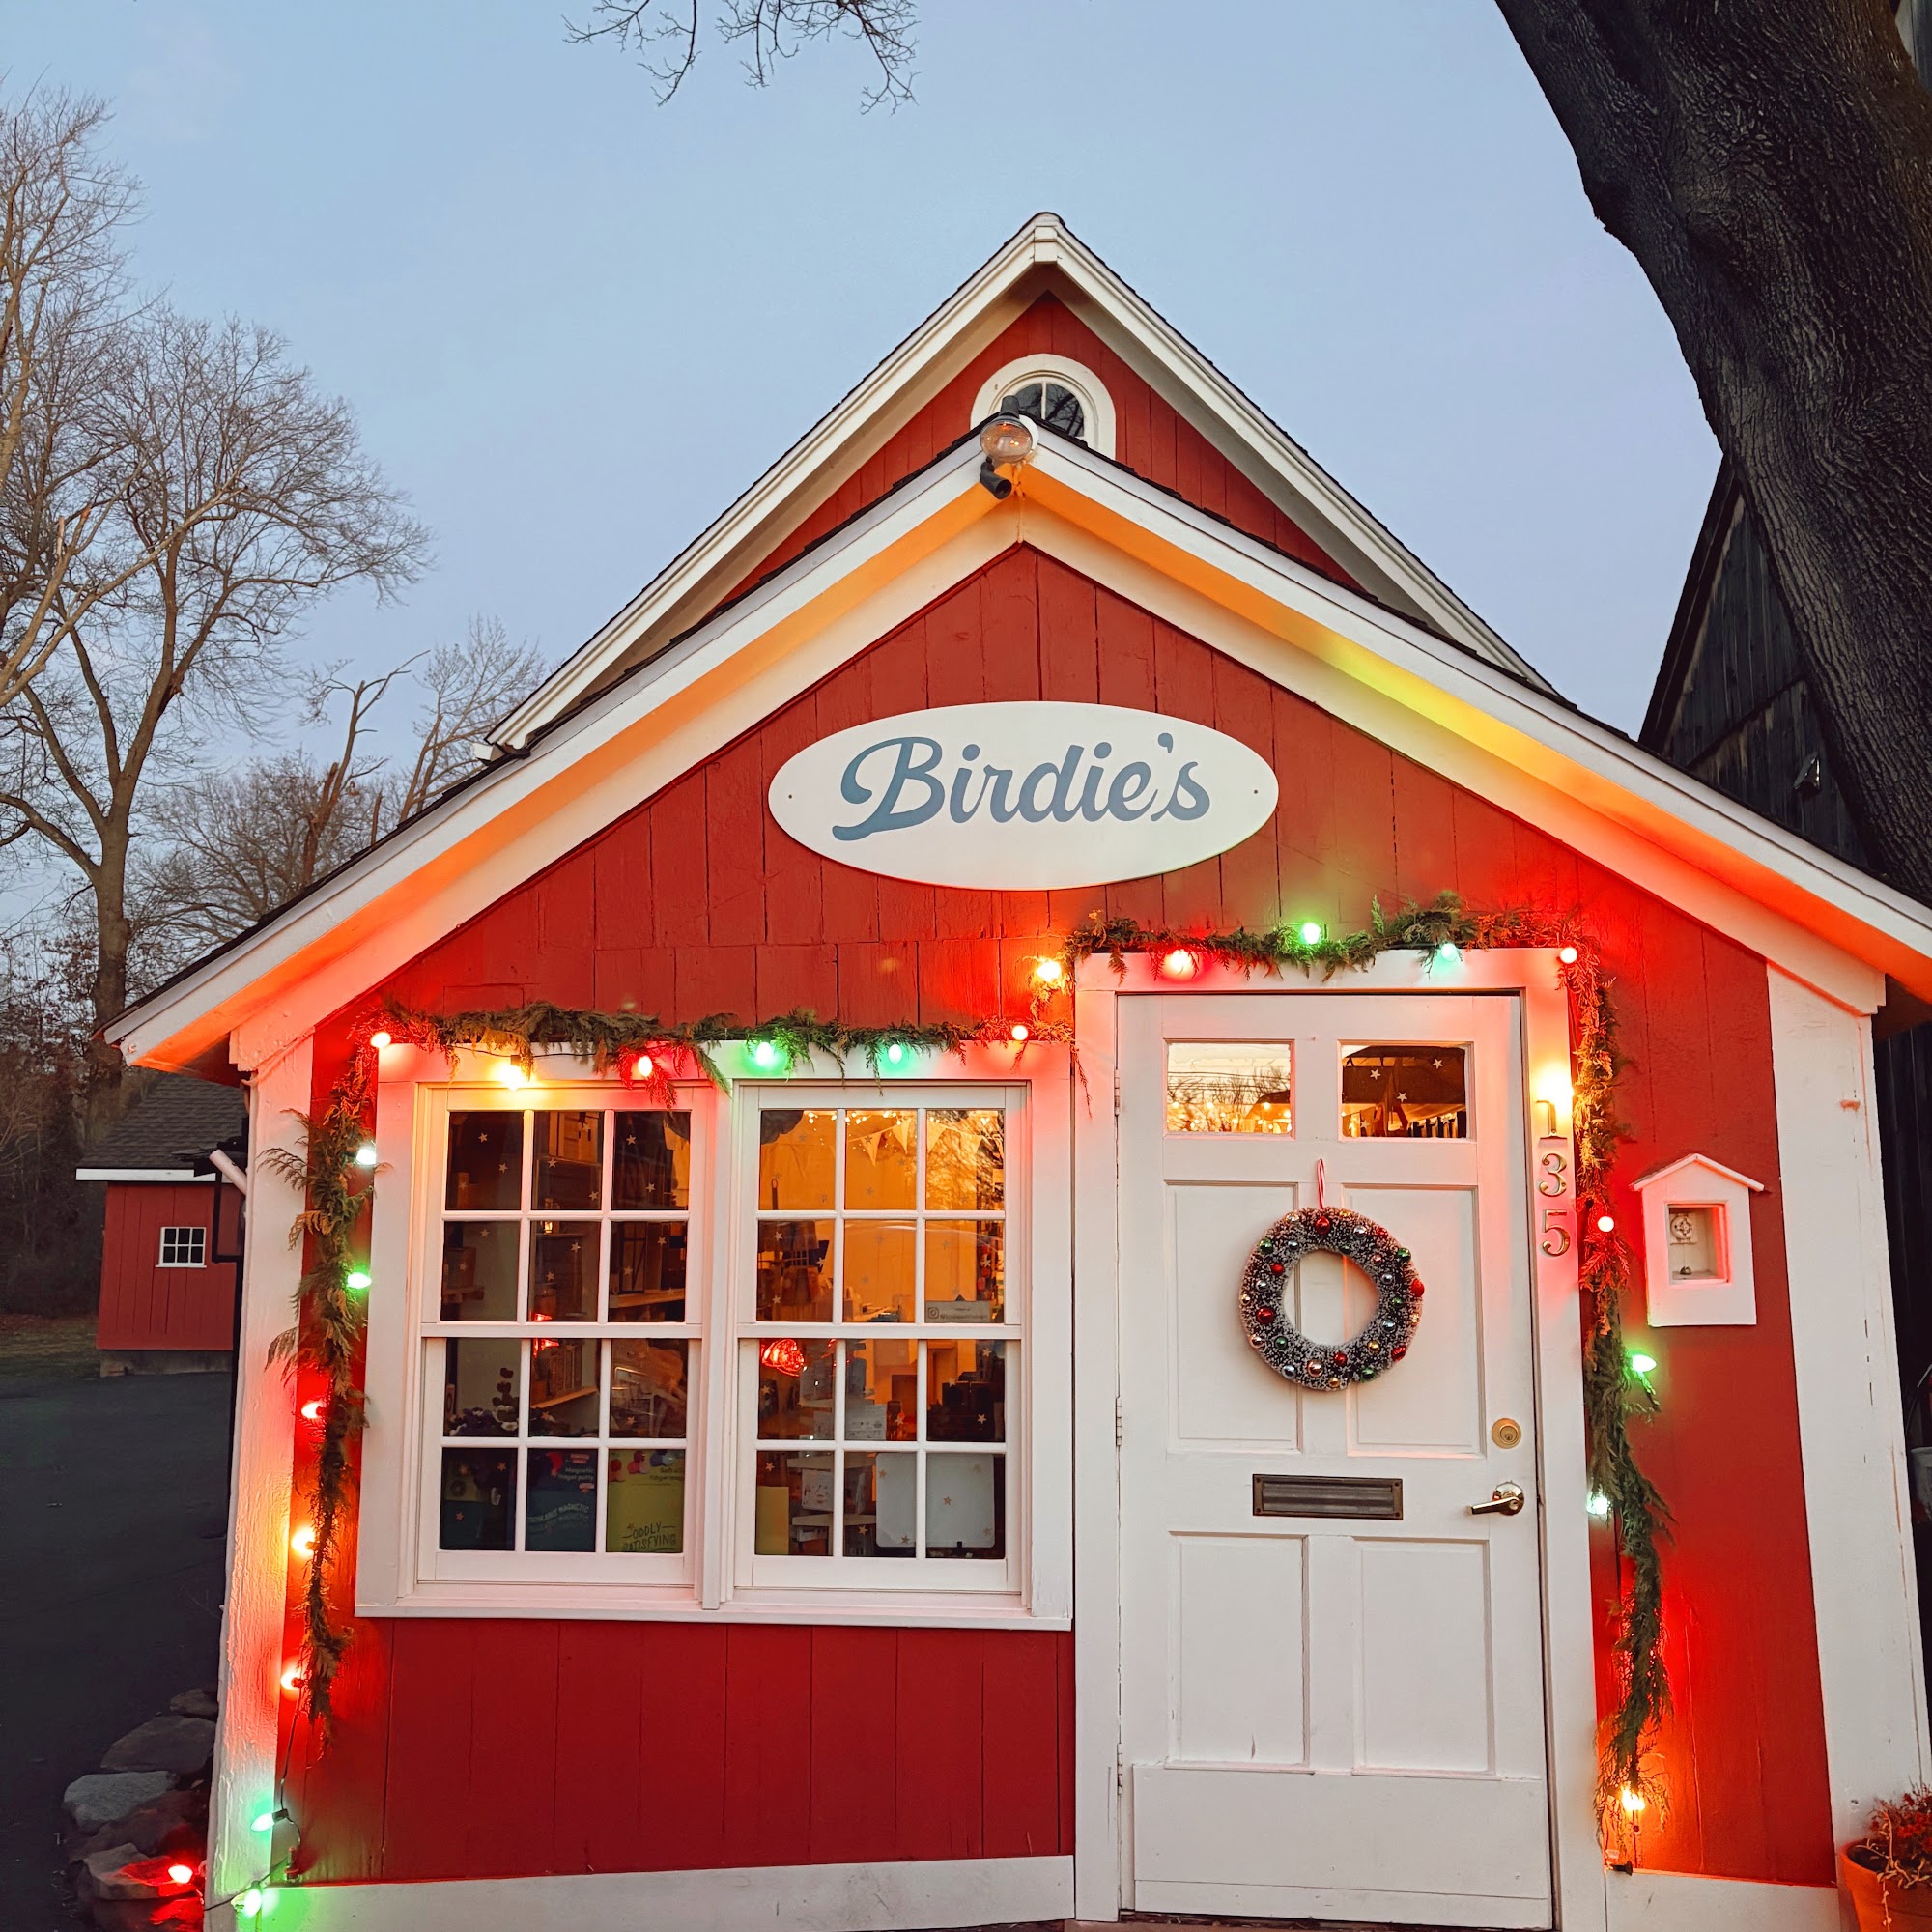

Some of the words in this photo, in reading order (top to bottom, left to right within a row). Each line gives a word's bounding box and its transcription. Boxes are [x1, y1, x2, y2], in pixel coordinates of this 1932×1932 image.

[832, 732, 1211, 841] Birdie's
[1536, 1099, 1571, 1257] 135
[633, 1522, 662, 1539] ODDLY
